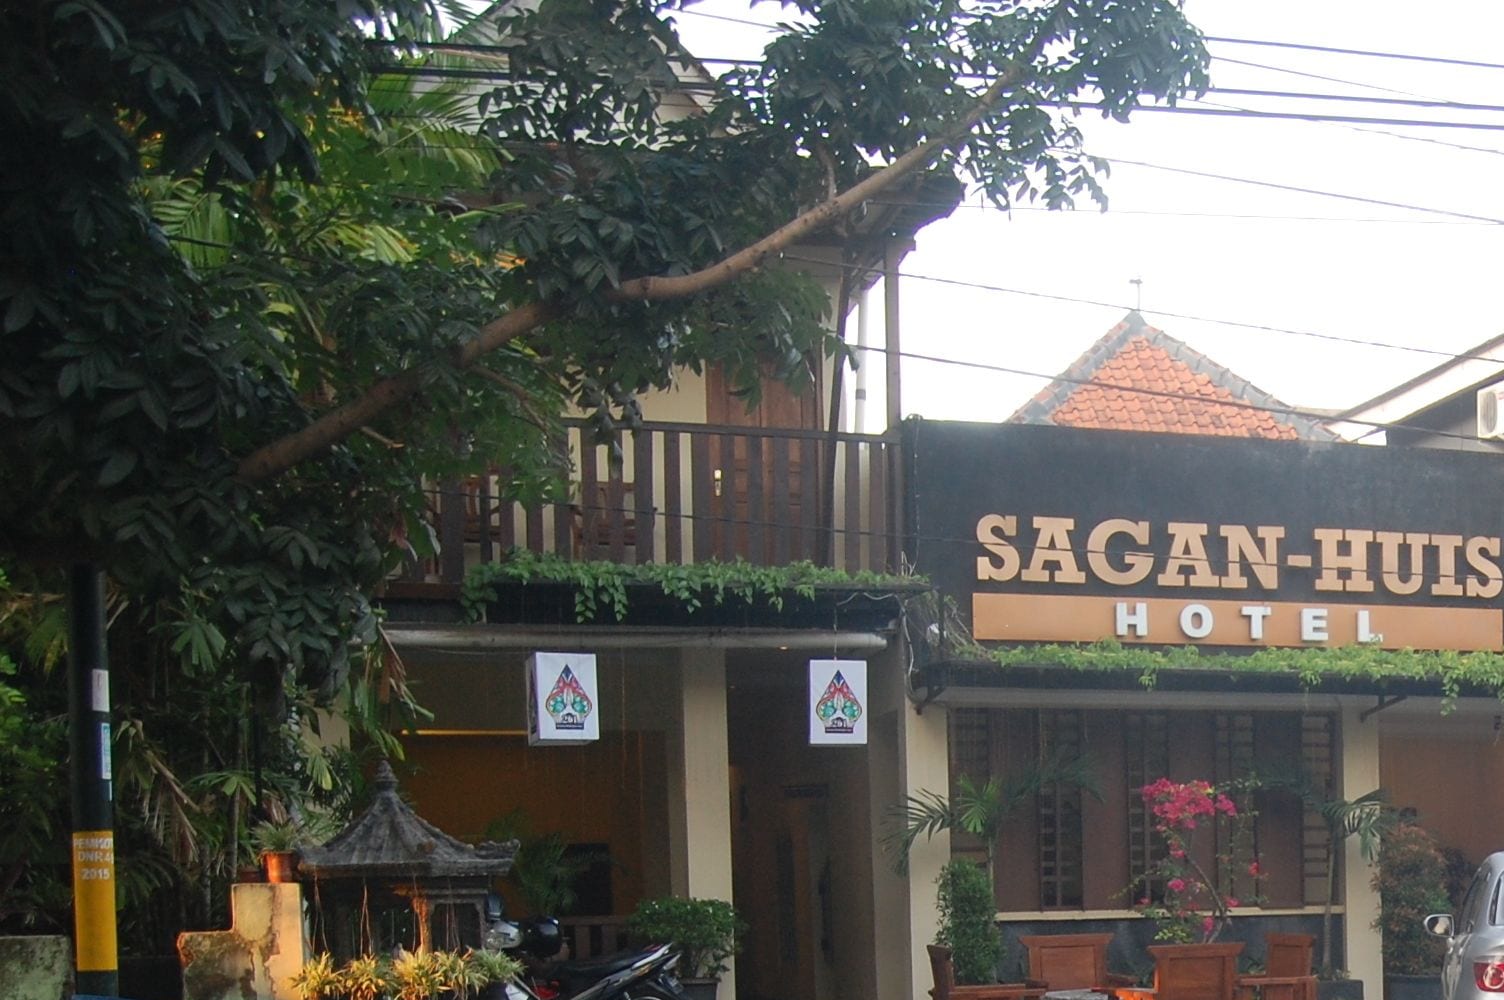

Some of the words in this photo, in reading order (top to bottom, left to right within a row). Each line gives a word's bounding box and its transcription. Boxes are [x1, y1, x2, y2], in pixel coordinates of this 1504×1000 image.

[976, 514, 1503, 598] SAGAN-HUIS
[1115, 602, 1384, 643] HOTEL
[81, 868, 110, 880] 2015
